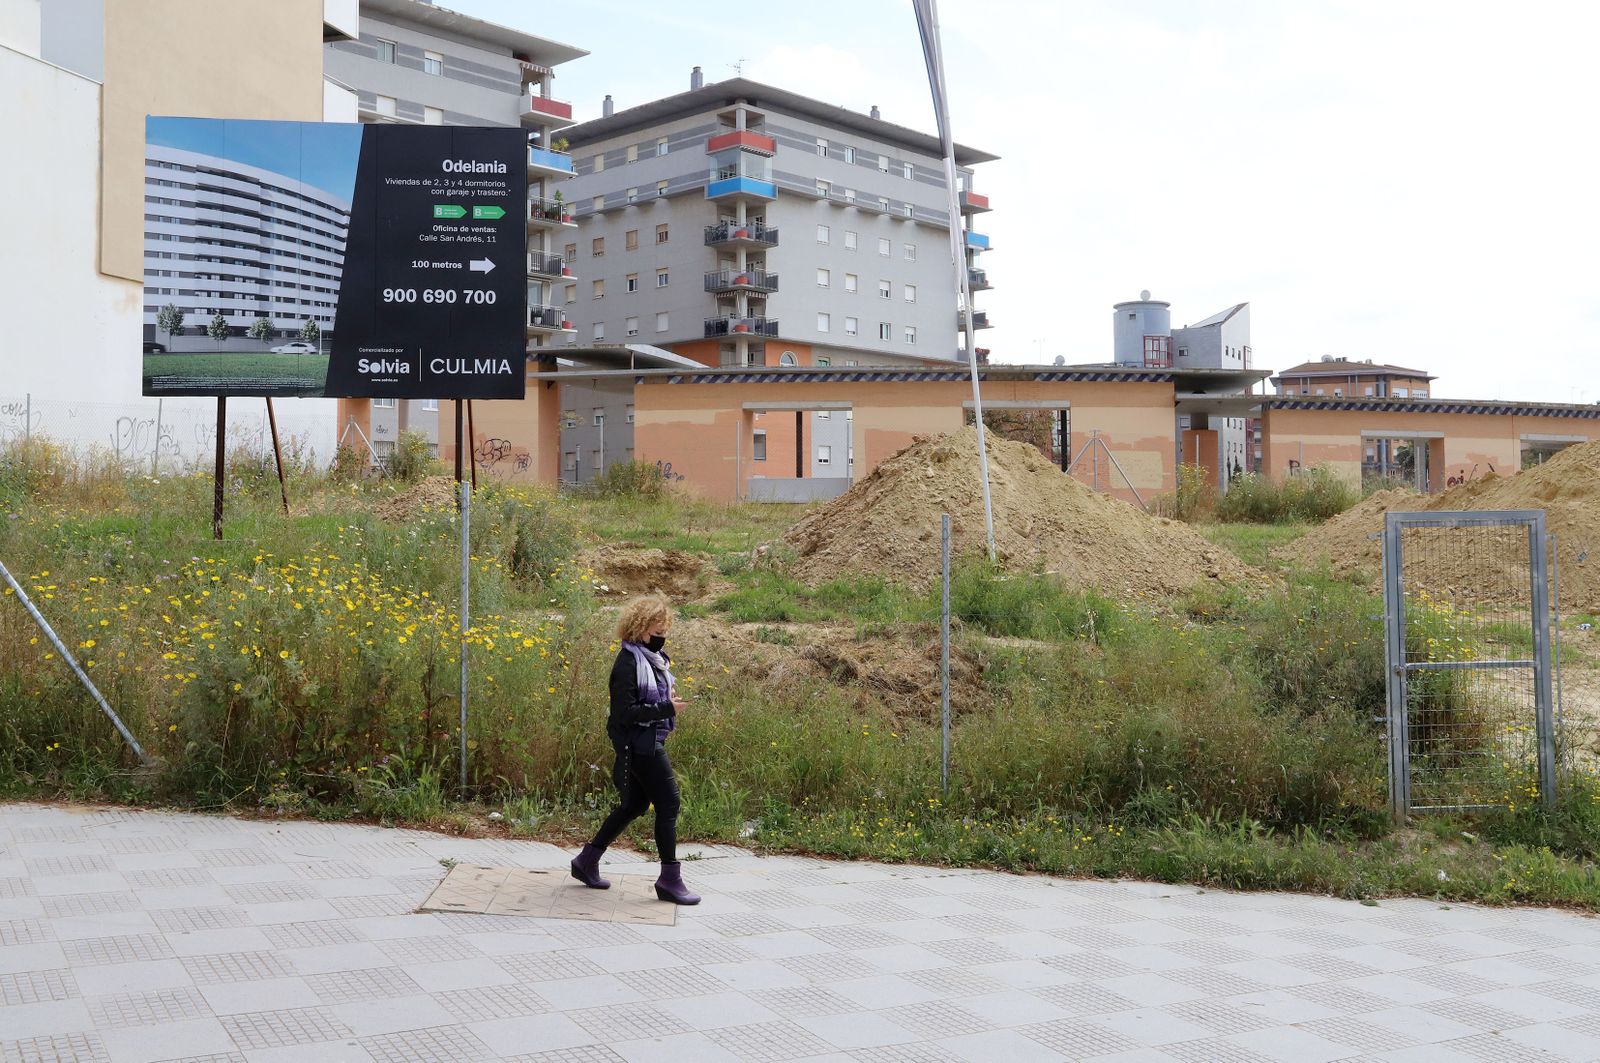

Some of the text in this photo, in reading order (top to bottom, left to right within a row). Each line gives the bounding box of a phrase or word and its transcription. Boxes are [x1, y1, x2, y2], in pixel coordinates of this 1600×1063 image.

[442, 159, 507, 174] Odelania
[385, 177, 420, 186] Viviendas
[422, 178, 432, 186] de
[465, 179, 506, 187] dormitorios
[446, 188, 469, 197] garaje
[435, 207, 442, 215] B
[474, 208, 482, 217] B
[432, 224, 458, 232] Oficina
[471, 225, 497, 233] ventas:
[419, 234, 438, 242] Calle
[457, 234, 485, 243] Andrés,
[411, 260, 463, 269] 100 metros
[383, 288, 497, 305] 900 690 700
[357, 358, 410, 374] Solvia
[430, 358, 512, 375] CULMIA
